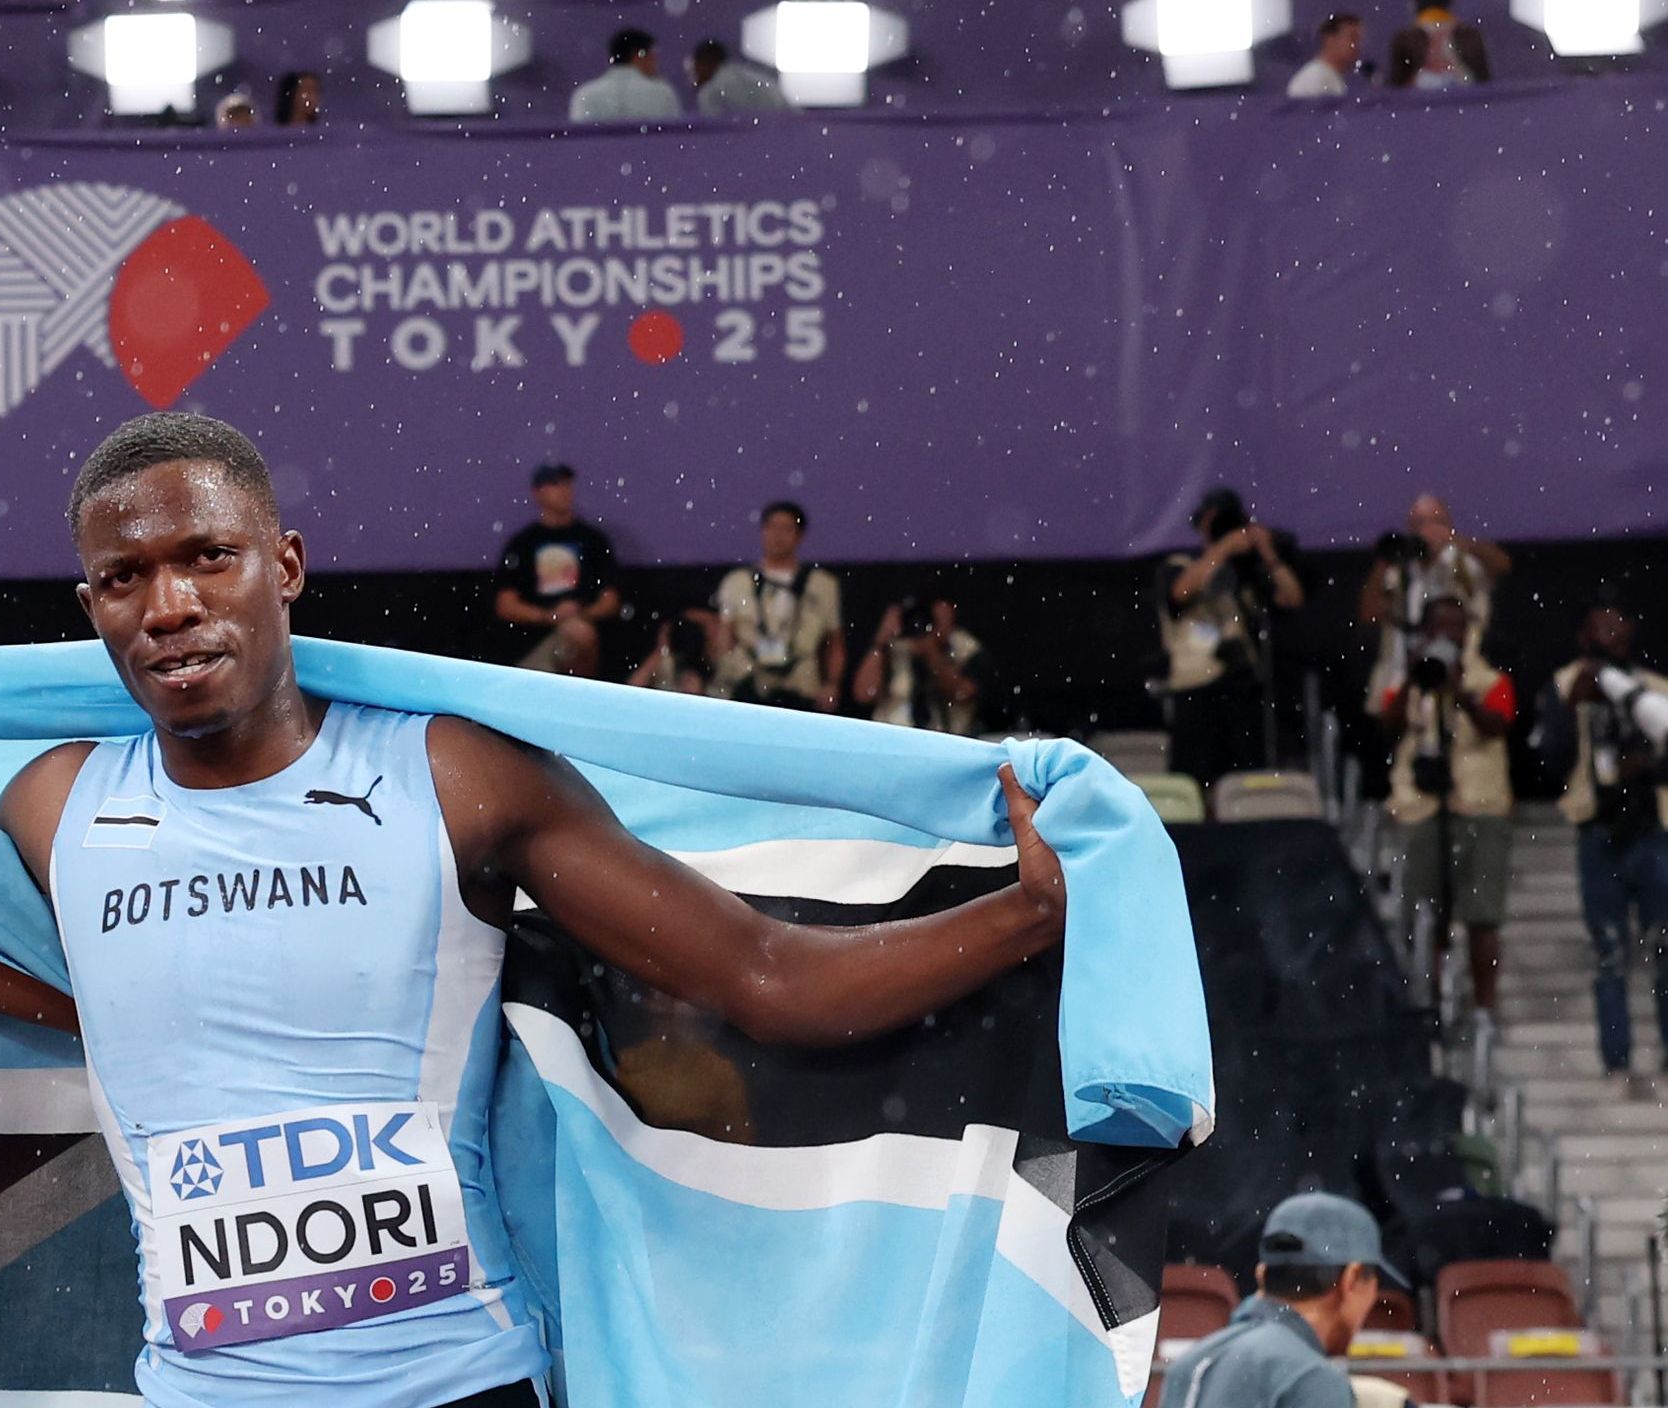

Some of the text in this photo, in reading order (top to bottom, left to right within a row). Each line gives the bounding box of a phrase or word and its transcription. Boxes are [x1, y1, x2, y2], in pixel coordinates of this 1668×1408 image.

[316, 202, 824, 257] WORLD ATHLETICS
[315, 252, 825, 312] CHAMPIONSHIPS
[102, 866, 367, 933] BOTSWANA
[219, 1112, 426, 1188] TDK
[179, 1184, 439, 1286] NDORI
